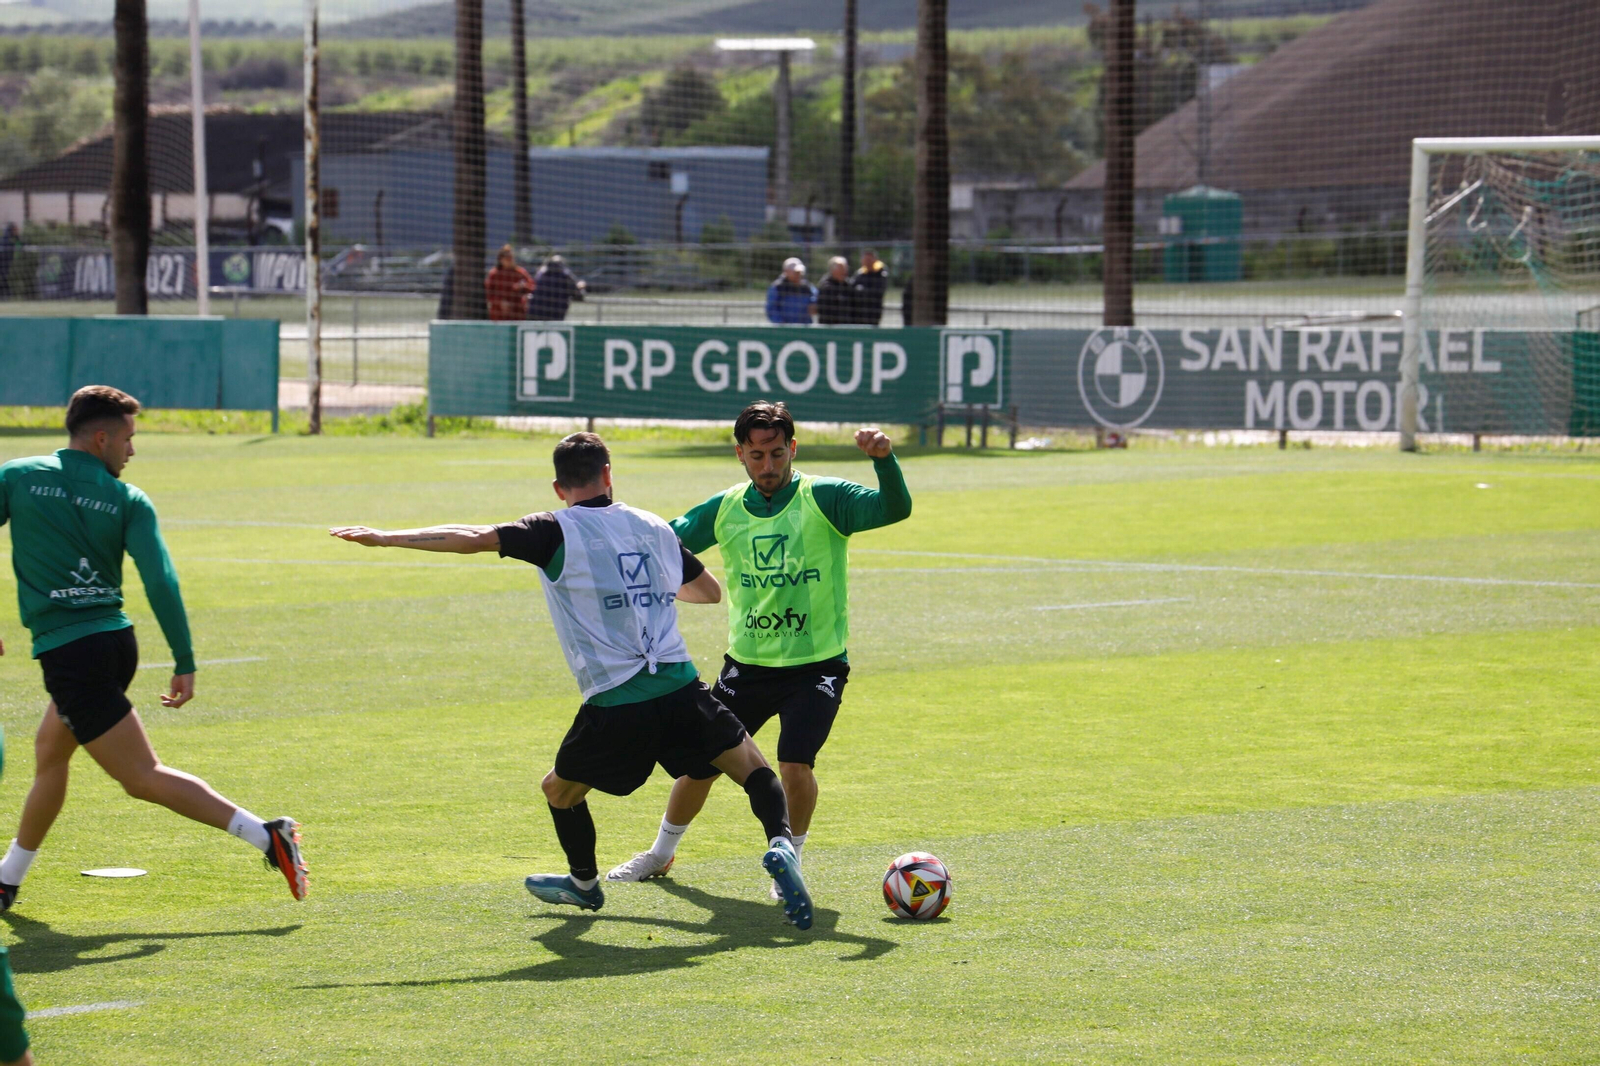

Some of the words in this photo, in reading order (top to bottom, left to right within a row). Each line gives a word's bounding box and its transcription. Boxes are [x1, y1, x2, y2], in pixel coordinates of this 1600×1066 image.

[604, 339, 675, 391] RP
[692, 339, 907, 396] GROUP
[1181, 326, 1282, 371] SAN
[1298, 327, 1502, 373] RAFAEL
[1245, 379, 1430, 432] MOTOR
[741, 568, 821, 588] GIVOVA
